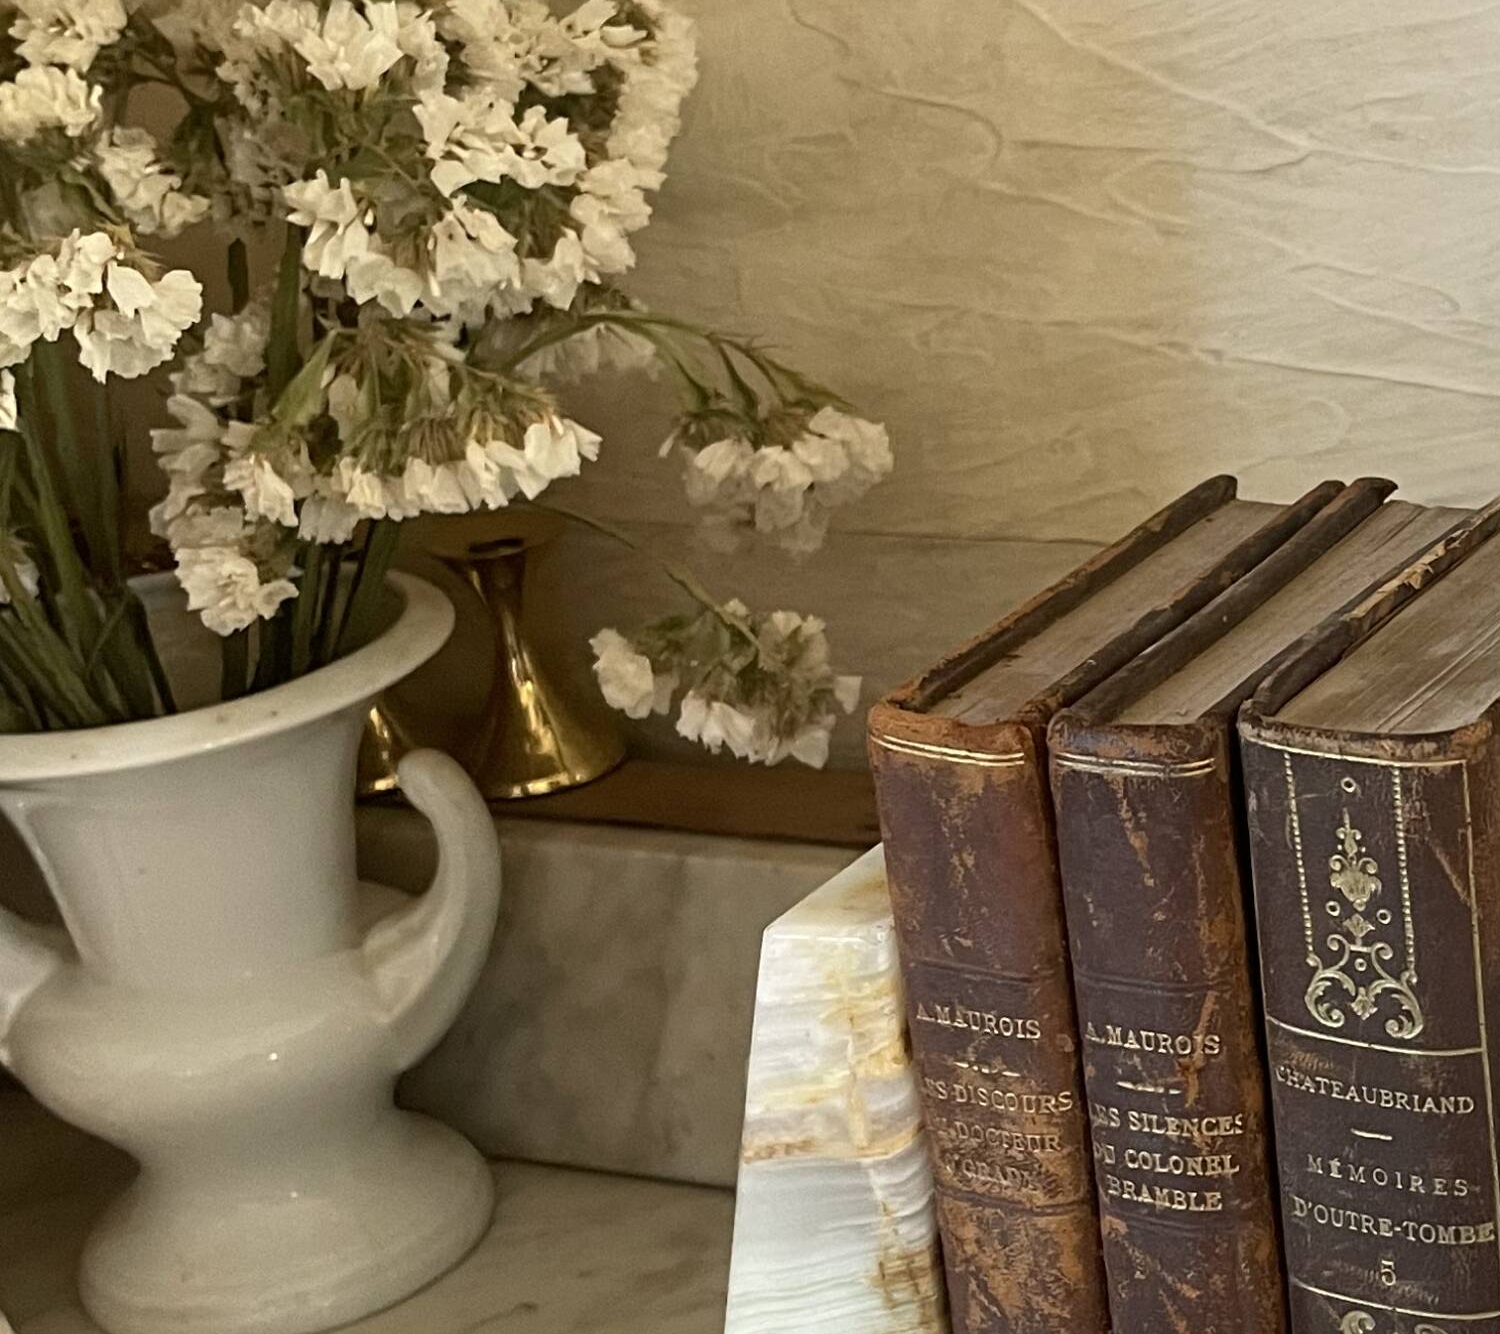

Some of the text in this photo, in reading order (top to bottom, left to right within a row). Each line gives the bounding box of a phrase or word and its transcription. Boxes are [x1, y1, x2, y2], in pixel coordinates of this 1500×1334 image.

[953, 1083, 1074, 1114] DISCOURS
[1276, 1067, 1475, 1115] CHATEAUBRIAND
[954, 1120, 1062, 1153] DOCTEUR
[1128, 1111, 1244, 1137] SILENCES
[1124, 1148, 1240, 1176] COLONEL
[1307, 1154, 1469, 1197] MÉMOIRES
[1106, 1174, 1223, 1212] BRAMBLE
[1291, 1194, 1496, 1246] D'OUTRE-TOMBE
[1381, 1259, 1397, 1286] 5
